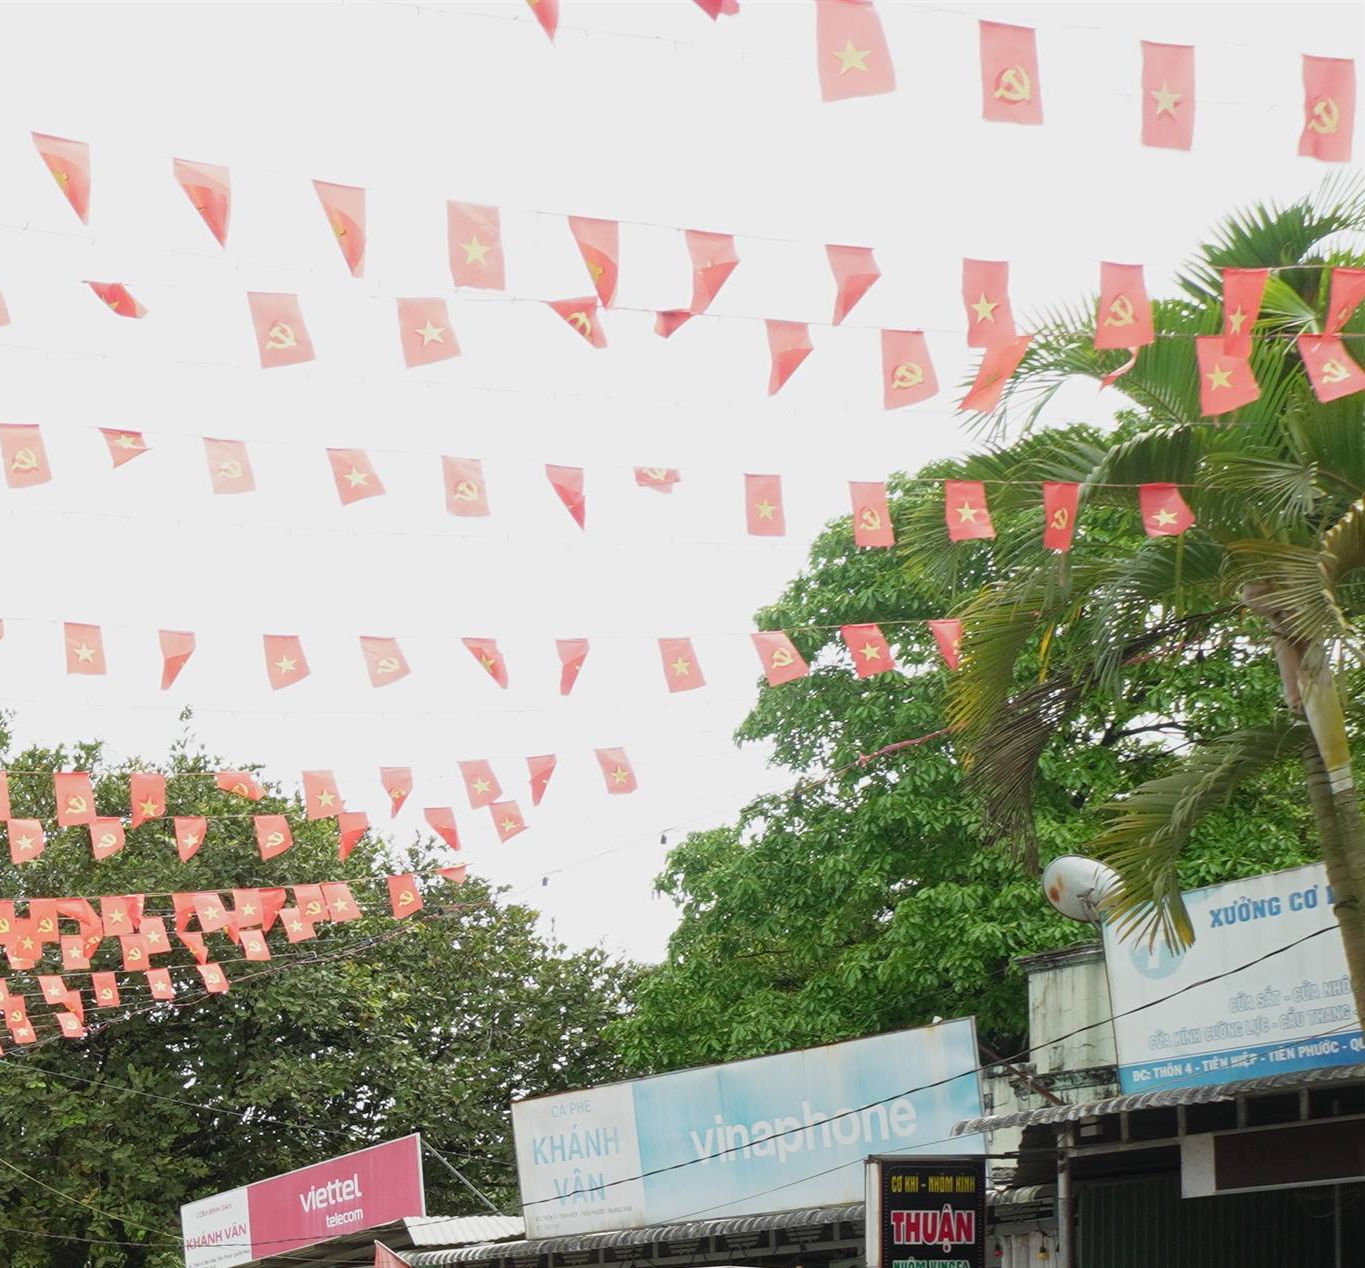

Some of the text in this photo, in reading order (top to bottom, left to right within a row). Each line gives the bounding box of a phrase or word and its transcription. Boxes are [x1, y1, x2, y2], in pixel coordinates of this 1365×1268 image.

[1209, 896, 1281, 929] XƯỞNG
[1289, 885, 1318, 912] CƠ
[1323, 975, 1351, 998] NHÔ
[1153, 1063, 1182, 1079] THÔN
[1185, 1064, 1192, 1075] 4
[1202, 1056, 1228, 1072] TIÊN
[532, 1124, 620, 1166] KHÁNH
[689, 1099, 918, 1164] vinaphone
[299, 1173, 362, 1214] viettel
[554, 1168, 606, 1206] VÂN
[186, 1222, 247, 1251] KHÁNH VÂN
[326, 1208, 364, 1228] telecom
[891, 1204, 976, 1253] THUẬN
